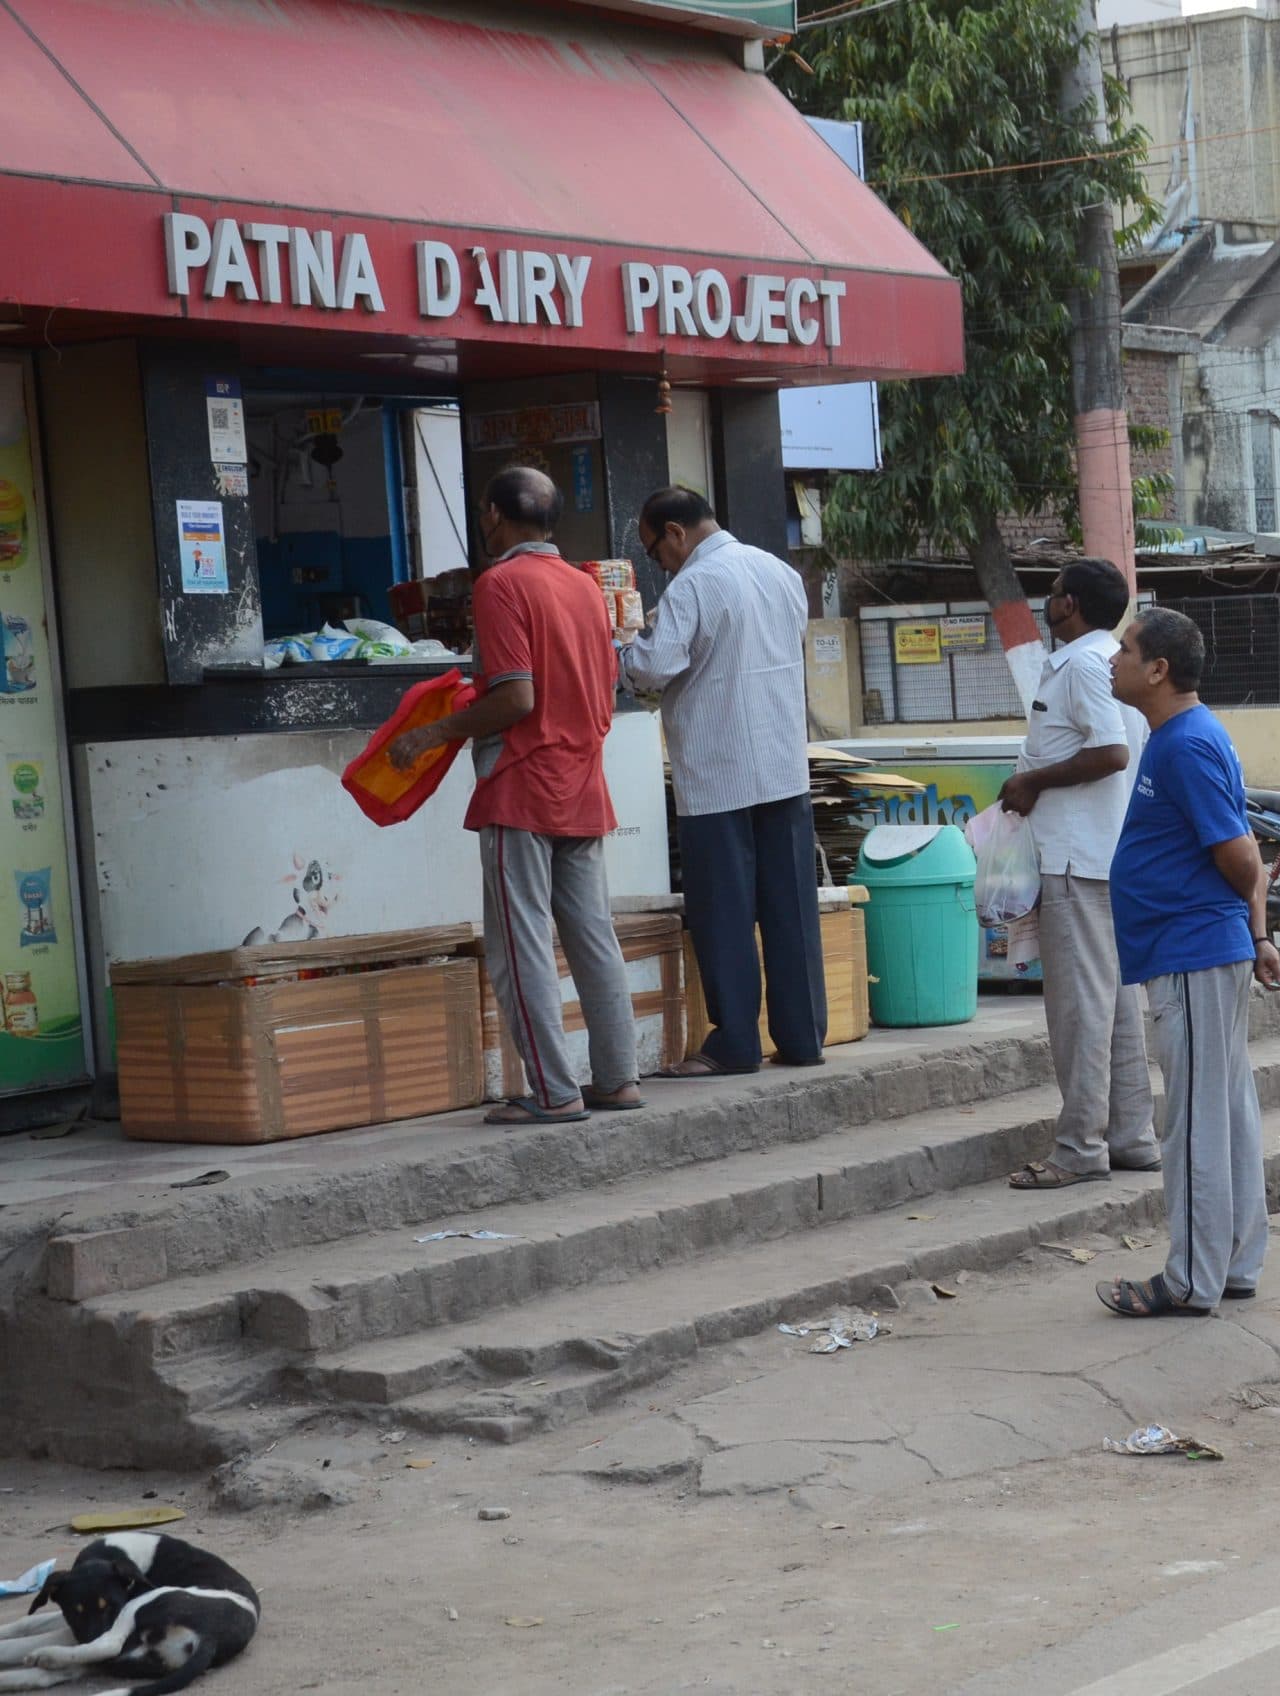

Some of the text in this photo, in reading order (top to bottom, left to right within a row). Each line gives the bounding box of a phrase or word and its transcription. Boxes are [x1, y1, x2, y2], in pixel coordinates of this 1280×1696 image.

[162, 211, 386, 313] PATNA
[620, 261, 847, 348] PROJECT
[959, 616, 984, 624] PARKING
